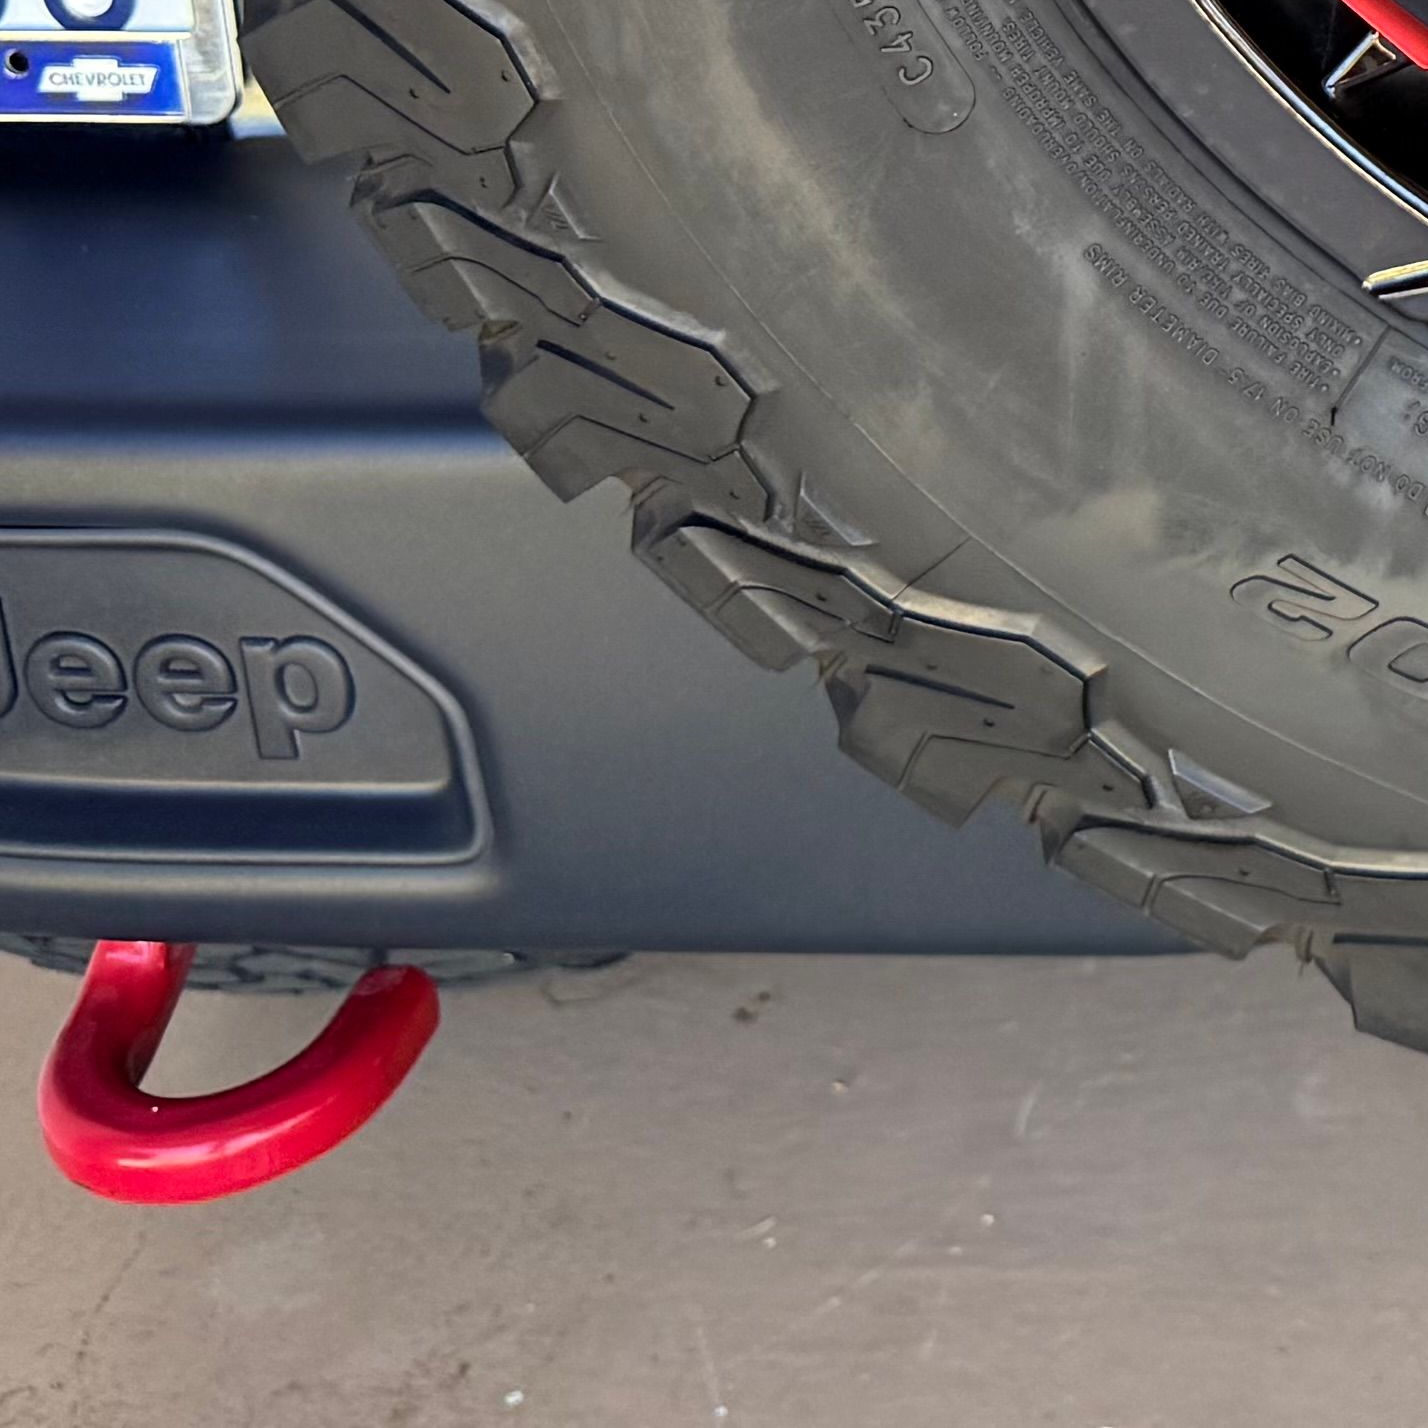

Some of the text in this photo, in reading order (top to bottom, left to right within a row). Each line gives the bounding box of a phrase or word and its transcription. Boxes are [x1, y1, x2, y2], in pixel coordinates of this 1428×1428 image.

[941, 3, 990, 62] FOLLOW
[47, 72, 148, 87] CHEVROLET
[1079, 239, 1127, 288] RIMS
[1230, 268, 1307, 331] SPECIALLY
[1127, 281, 1221, 367] DIAMETER
[1229, 314, 1287, 365] FAILURE
[1271, 394, 1301, 423] ON
[1301, 415, 1347, 455] USE
[1344, 444, 1393, 483] NOT
[1392, 471, 1427, 502] DO
